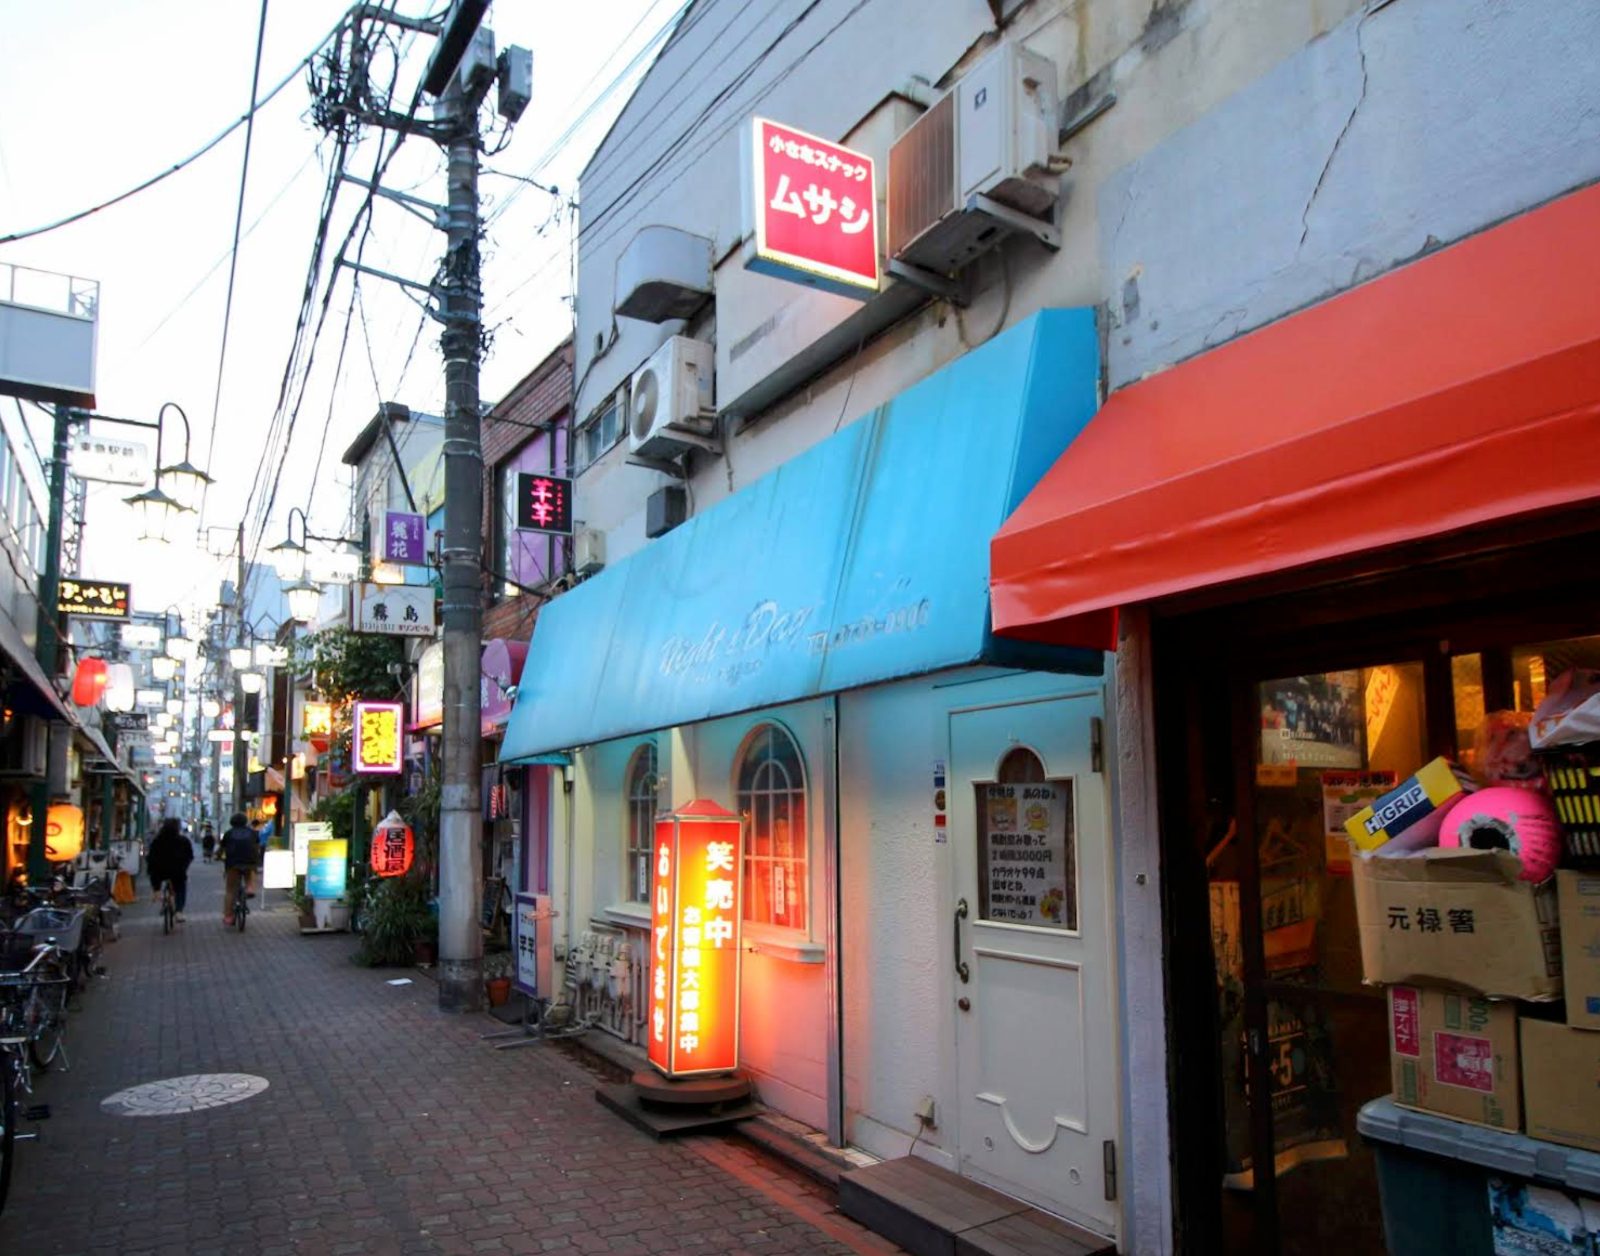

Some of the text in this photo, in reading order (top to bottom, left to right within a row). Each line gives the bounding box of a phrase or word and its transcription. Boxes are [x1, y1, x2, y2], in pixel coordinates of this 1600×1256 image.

[769, 133, 868, 182] 小さなスナック
[770, 174, 870, 235] ムサシ
[373, 602, 419, 623] 霧島
[398, 624, 431, 633] キリンビール
[1365, 786, 1425, 834] HiGRIP
[385, 828, 406, 872] 居酒屋
[992, 867, 1046, 879] カラオケ99点
[704, 841, 734, 949] 笑売中
[652, 843, 670, 1043] おいでませ
[1387, 905, 1477, 934] 元禄箸
[679, 905, 702, 1054] お客様大募集中
